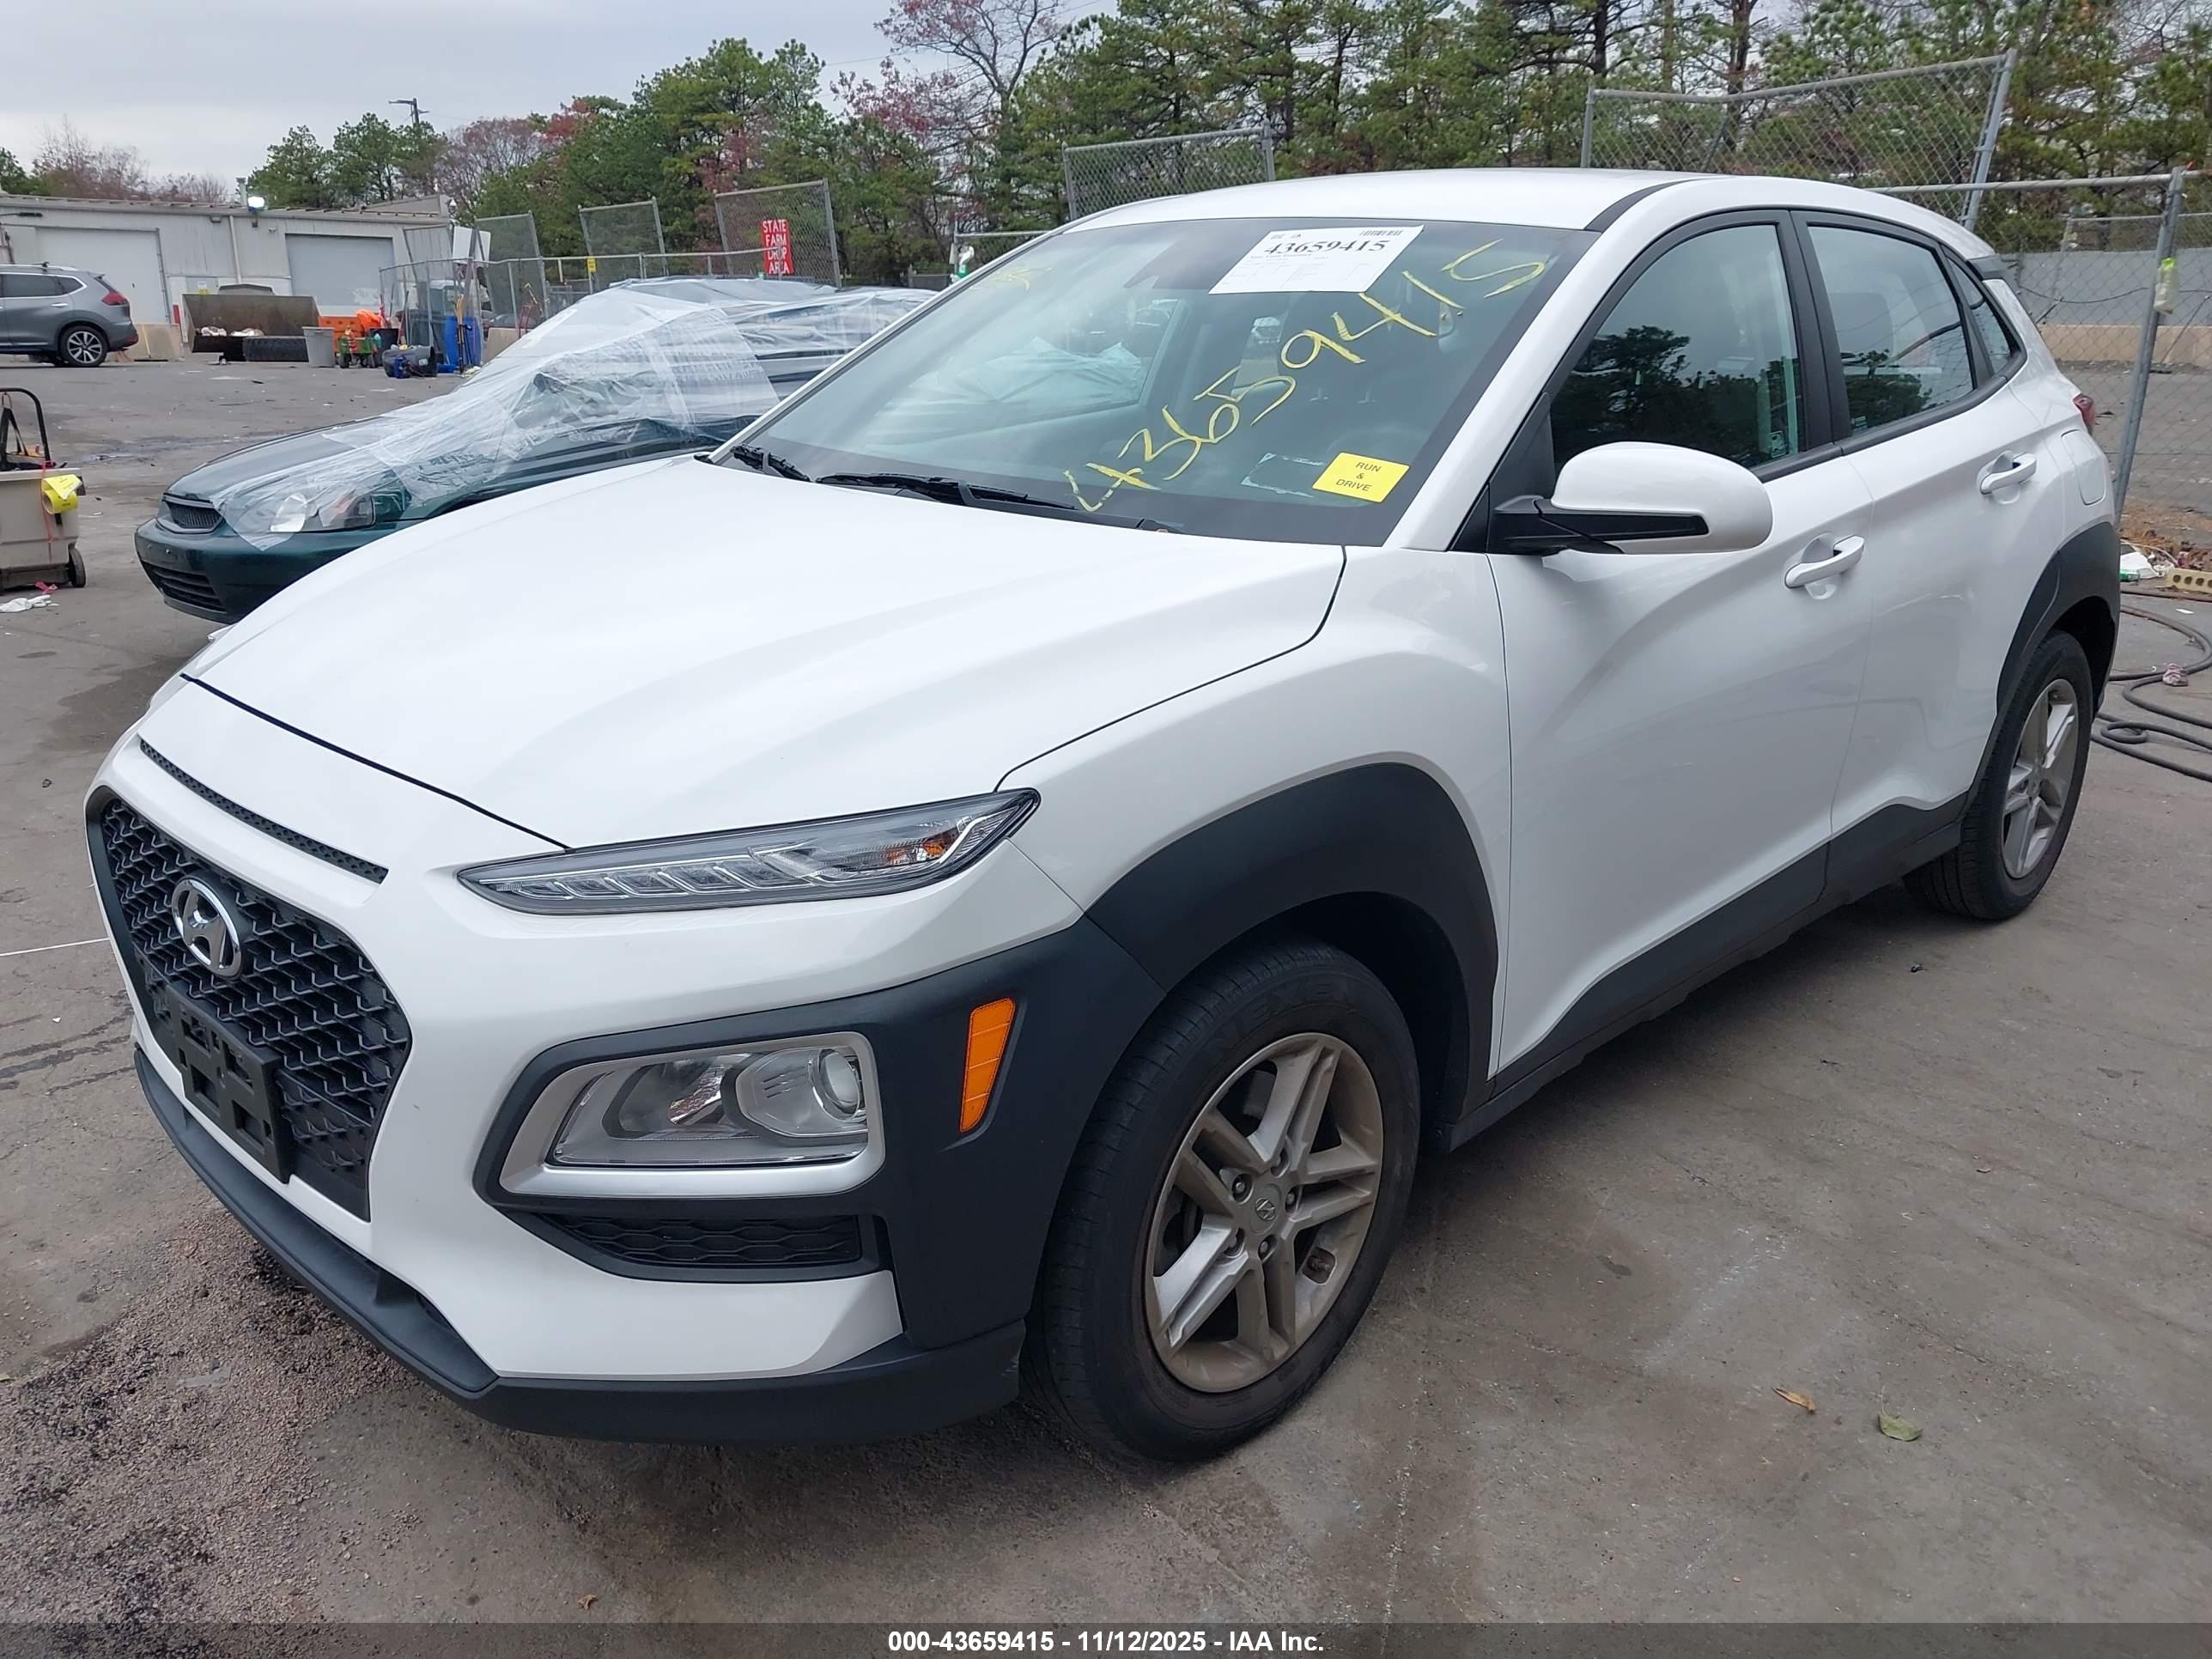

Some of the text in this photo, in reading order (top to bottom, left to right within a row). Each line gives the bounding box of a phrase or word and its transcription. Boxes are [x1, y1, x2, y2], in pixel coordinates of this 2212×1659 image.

[763, 220, 787, 234] STATE
[765, 233, 787, 247] FARM
[768, 246, 787, 261] DROP
[1264, 240, 1390, 255] 43659415
[1356, 462, 1382, 472] RUN
[1336, 478, 1372, 491] DRIVE
